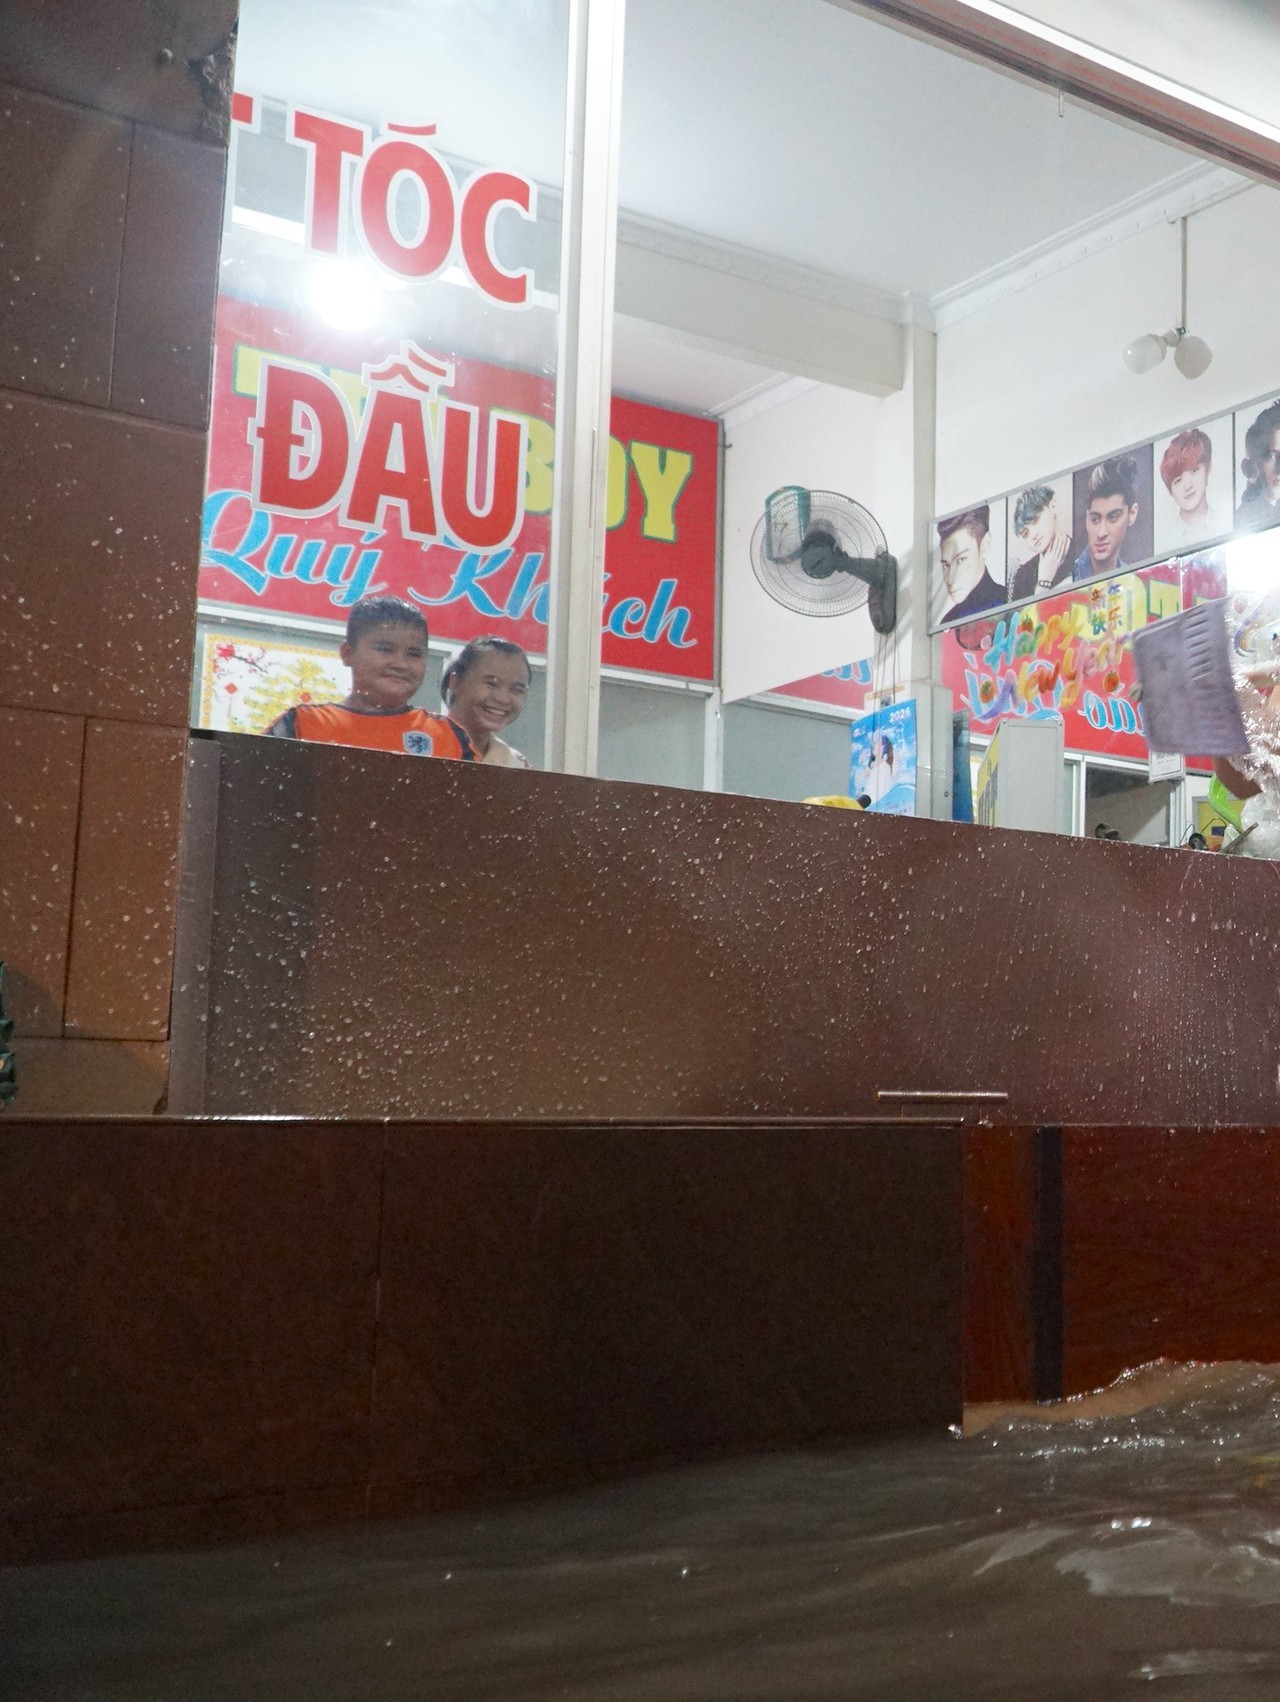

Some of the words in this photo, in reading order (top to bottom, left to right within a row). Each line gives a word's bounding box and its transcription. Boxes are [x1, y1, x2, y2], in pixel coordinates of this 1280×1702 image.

[293, 109, 532, 304] TÓC
[256, 350, 523, 548] ĐẦU
[200, 488, 387, 606] Quý
[407, 532, 698, 648] Khch
[889, 706, 911, 723] 2026
